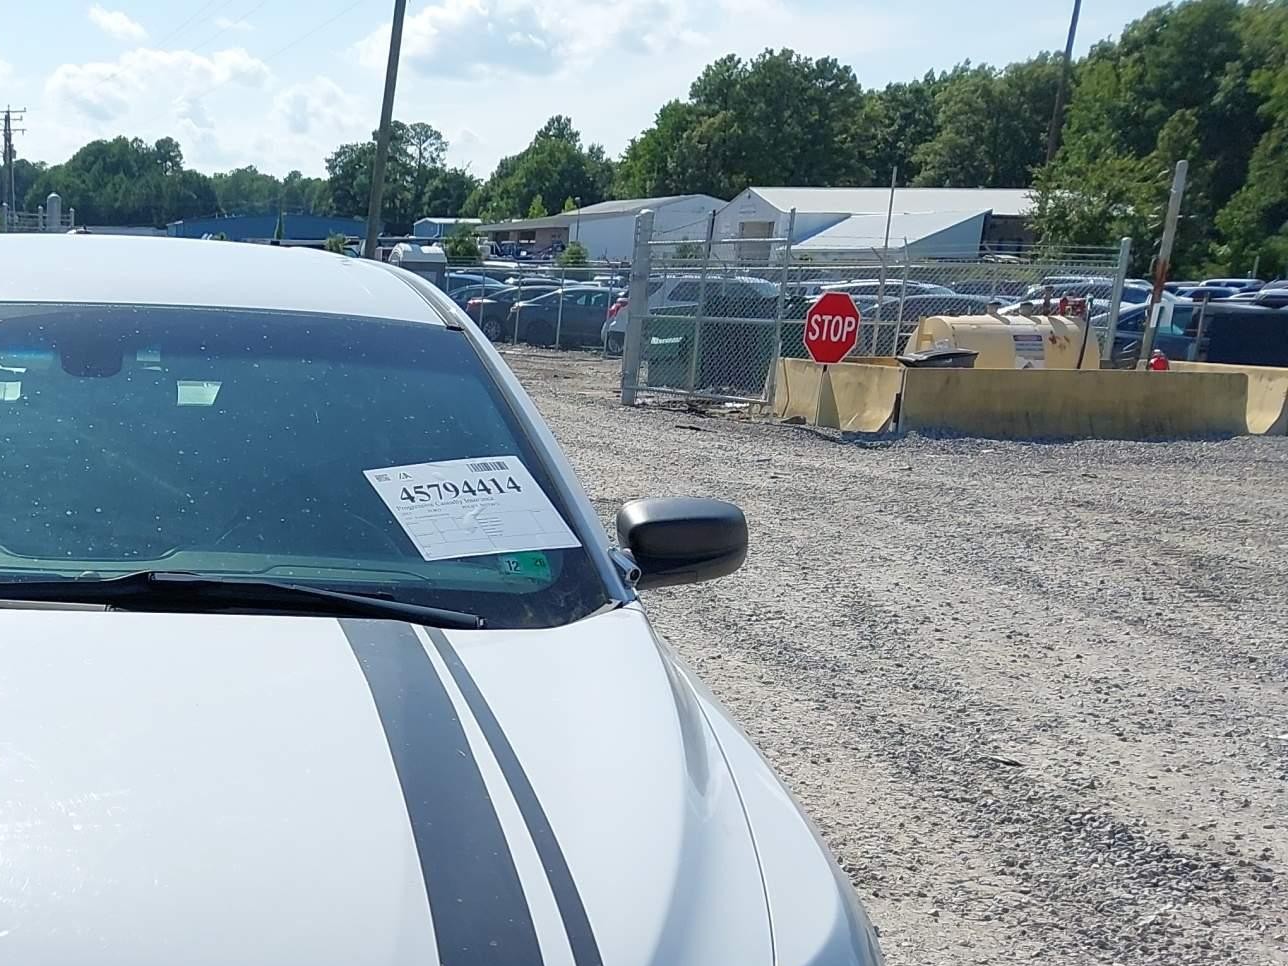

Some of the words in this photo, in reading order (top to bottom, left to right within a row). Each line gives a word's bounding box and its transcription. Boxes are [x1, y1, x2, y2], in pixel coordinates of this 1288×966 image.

[808, 313, 856, 343] STOP
[400, 476, 522, 503] 45794414
[505, 560, 521, 572] 12
